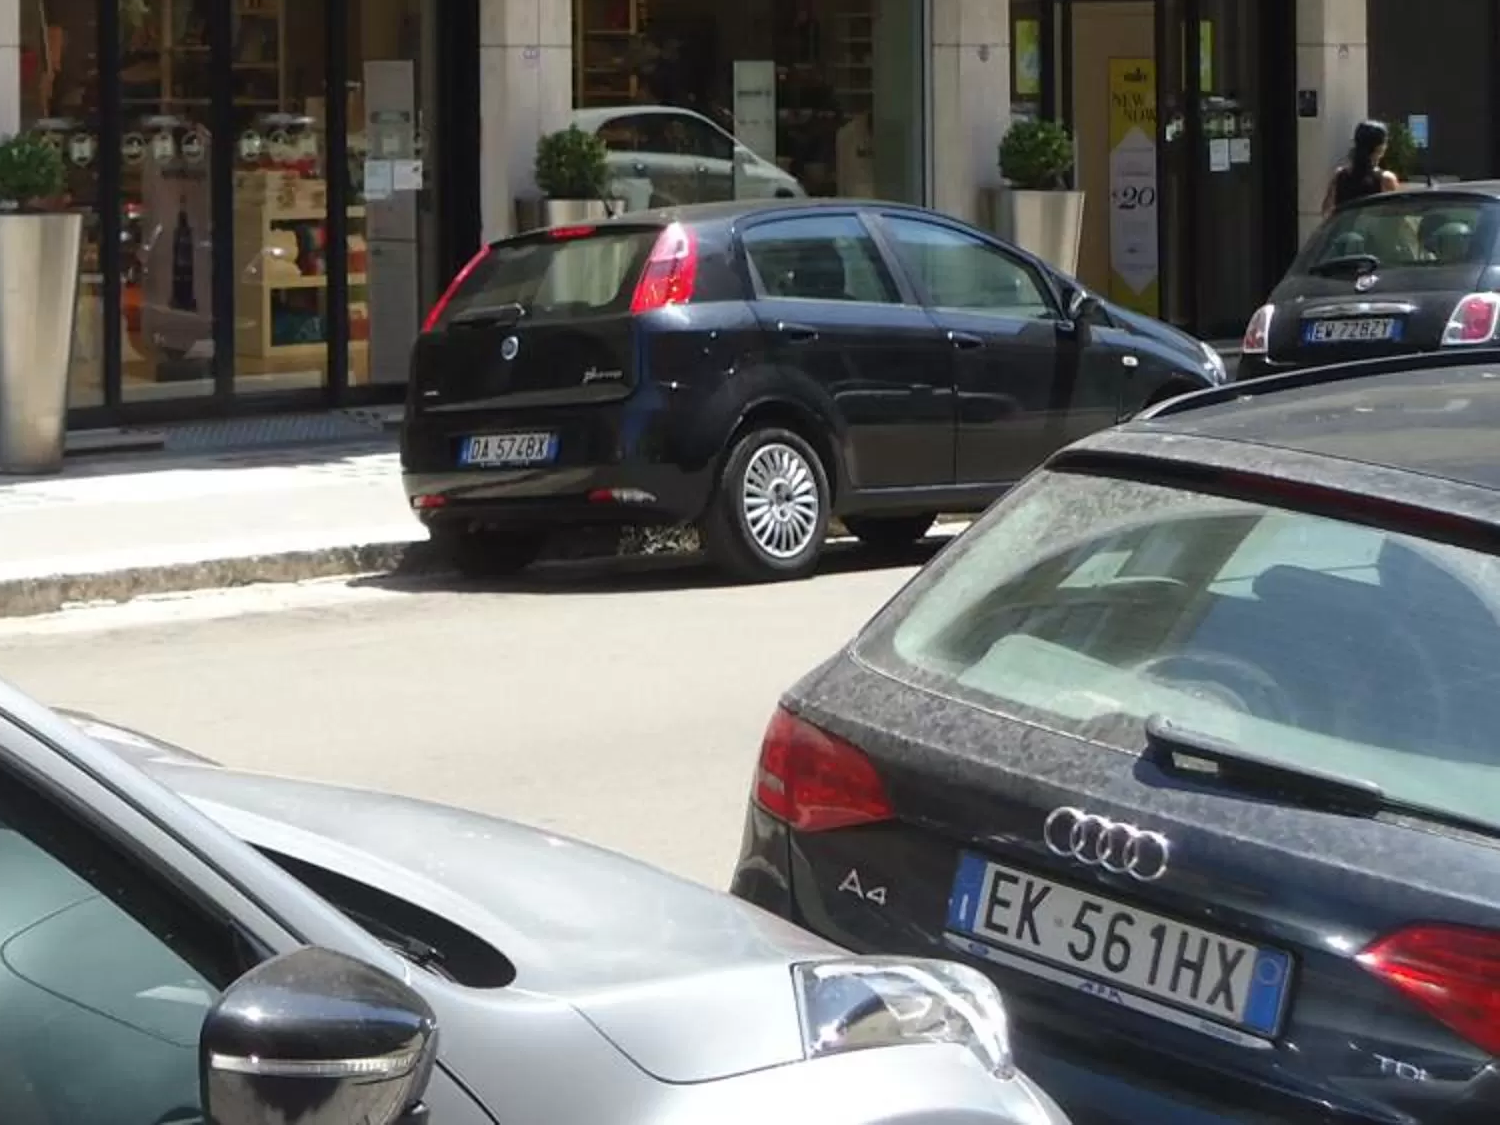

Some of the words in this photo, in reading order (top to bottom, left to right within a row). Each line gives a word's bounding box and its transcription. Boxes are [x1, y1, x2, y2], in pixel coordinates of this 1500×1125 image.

[838, 868, 888, 905] A4
[984, 870, 1052, 946] EK
[1067, 900, 1246, 1013] 561HX
